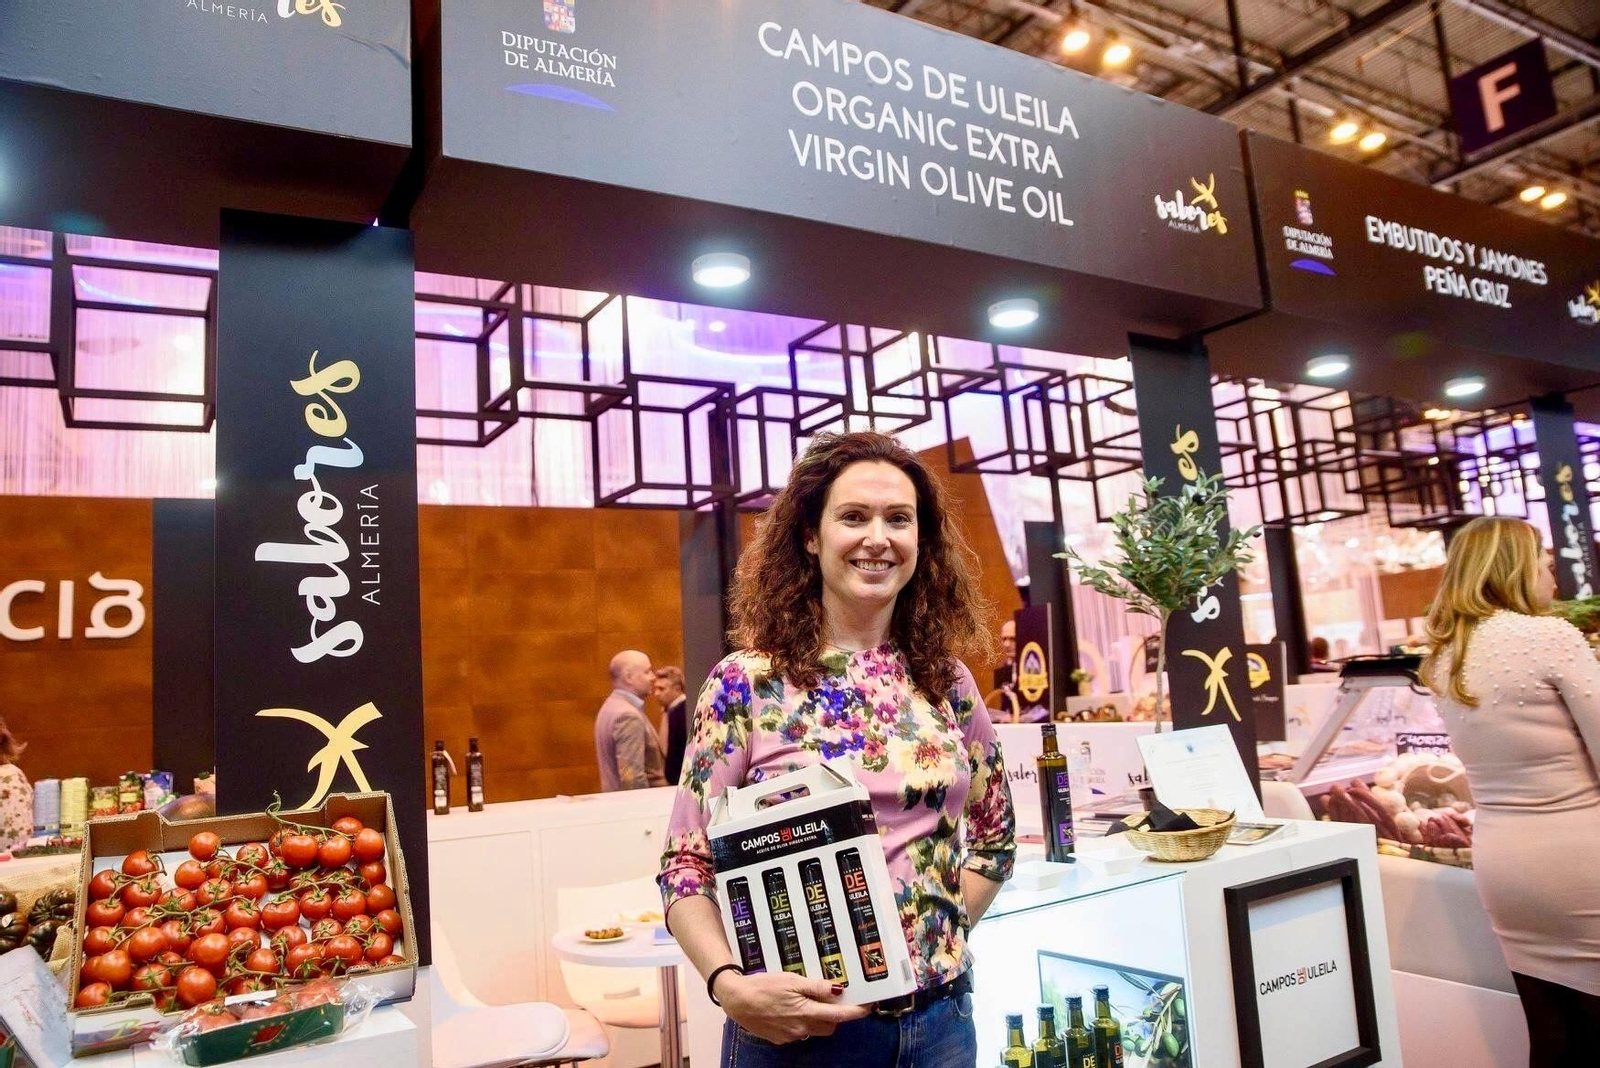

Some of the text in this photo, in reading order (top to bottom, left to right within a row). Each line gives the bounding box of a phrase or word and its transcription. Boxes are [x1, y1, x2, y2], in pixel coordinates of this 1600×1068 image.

[186, 0, 269, 24] ALMERÍA
[501, 31, 618, 70] DIPUTACIÓN
[505, 49, 617, 88] DE ALMERÍA
[758, 21, 1080, 140] CAMPOS DE ULEILA
[1477, 62, 1521, 133] F
[792, 80, 1064, 179] ORGANIC EXTRA
[788, 129, 1075, 227] VIRGIN OLIVE OIL
[1154, 189, 1228, 235] sabores
[1283, 225, 1333, 247] DIPUTACIÓN
[1286, 238, 1301, 251] DE
[1365, 214, 1549, 285] EMBUTIDOS Y JAMONES
[1423, 265, 1513, 308] PEÑA CRUZ
[254, 349, 365, 664] sabores
[358, 482, 382, 607] ALMERÍA
[741, 819, 829, 851] CAMPOS DE ULEILA
[805, 883, 825, 901] DE
[844, 871, 866, 889] DE
[769, 893, 790, 910] DE
[1259, 960, 1338, 996] CAMPOS DE ULEILA
